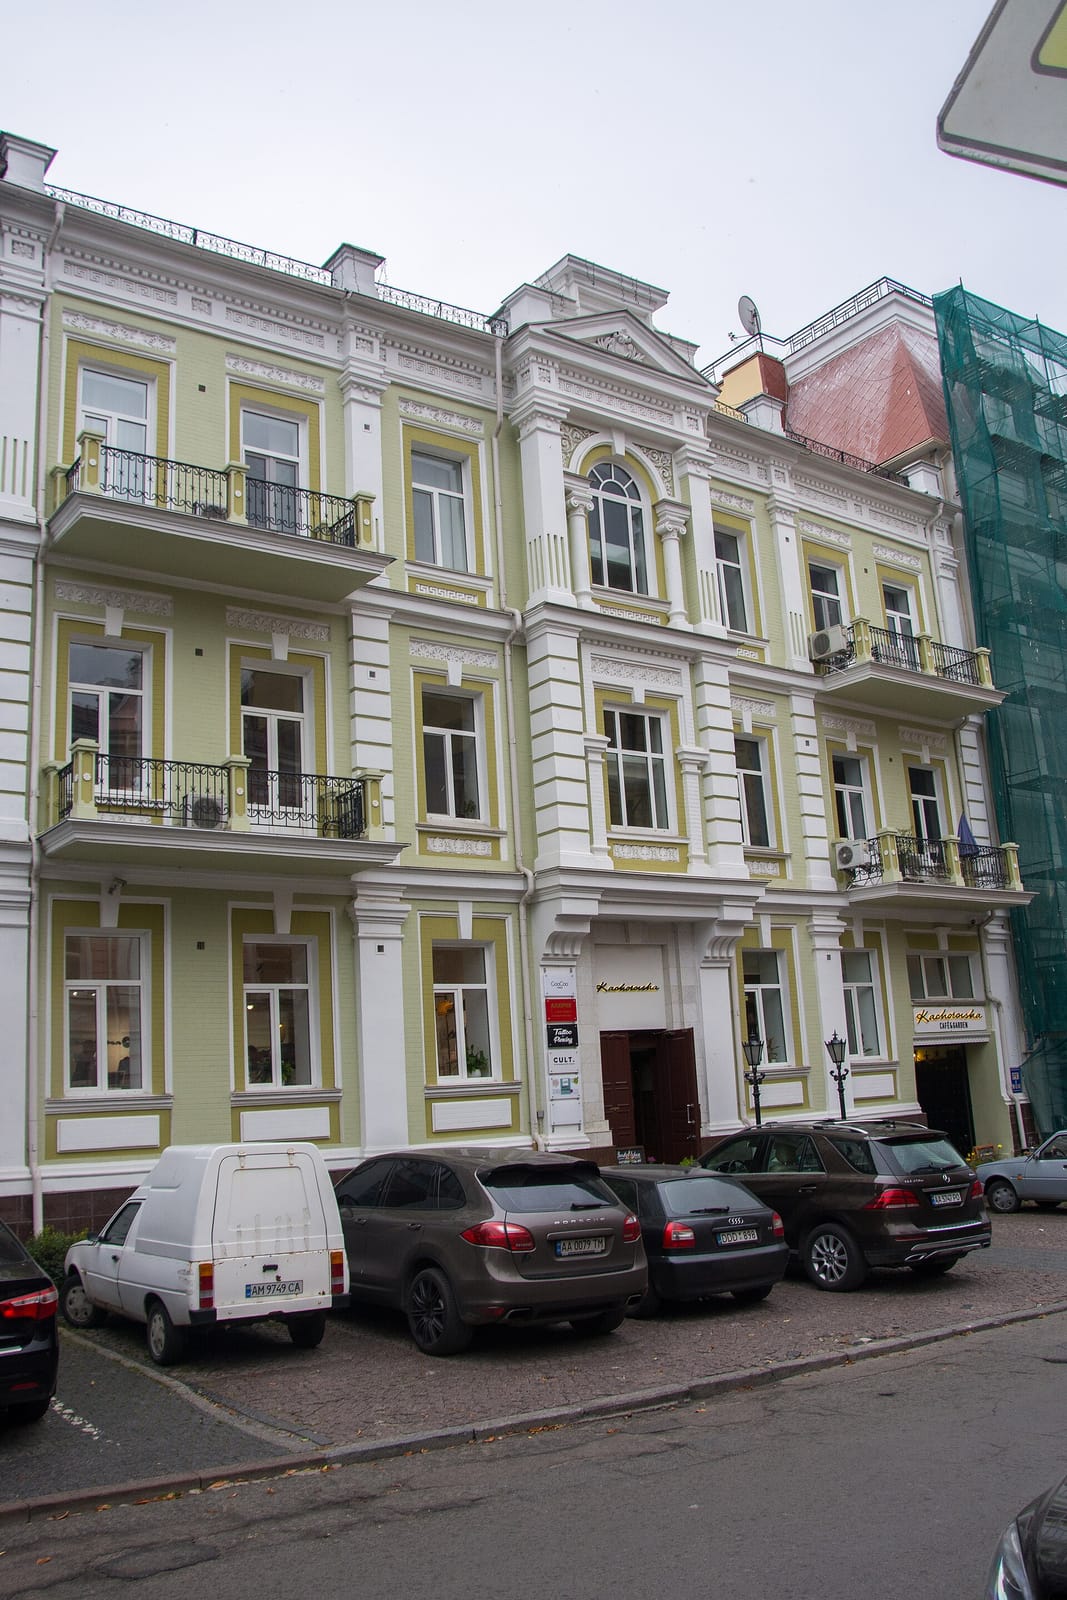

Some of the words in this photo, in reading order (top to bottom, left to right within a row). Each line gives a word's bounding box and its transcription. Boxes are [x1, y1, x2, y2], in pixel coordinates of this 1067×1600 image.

[562, 1240, 572, 1251] AA
[593, 1238, 604, 1249] TM
[251, 1285, 265, 1296] AM
[266, 1283, 287, 1295] 9749
[288, 1281, 300, 1292] CA
